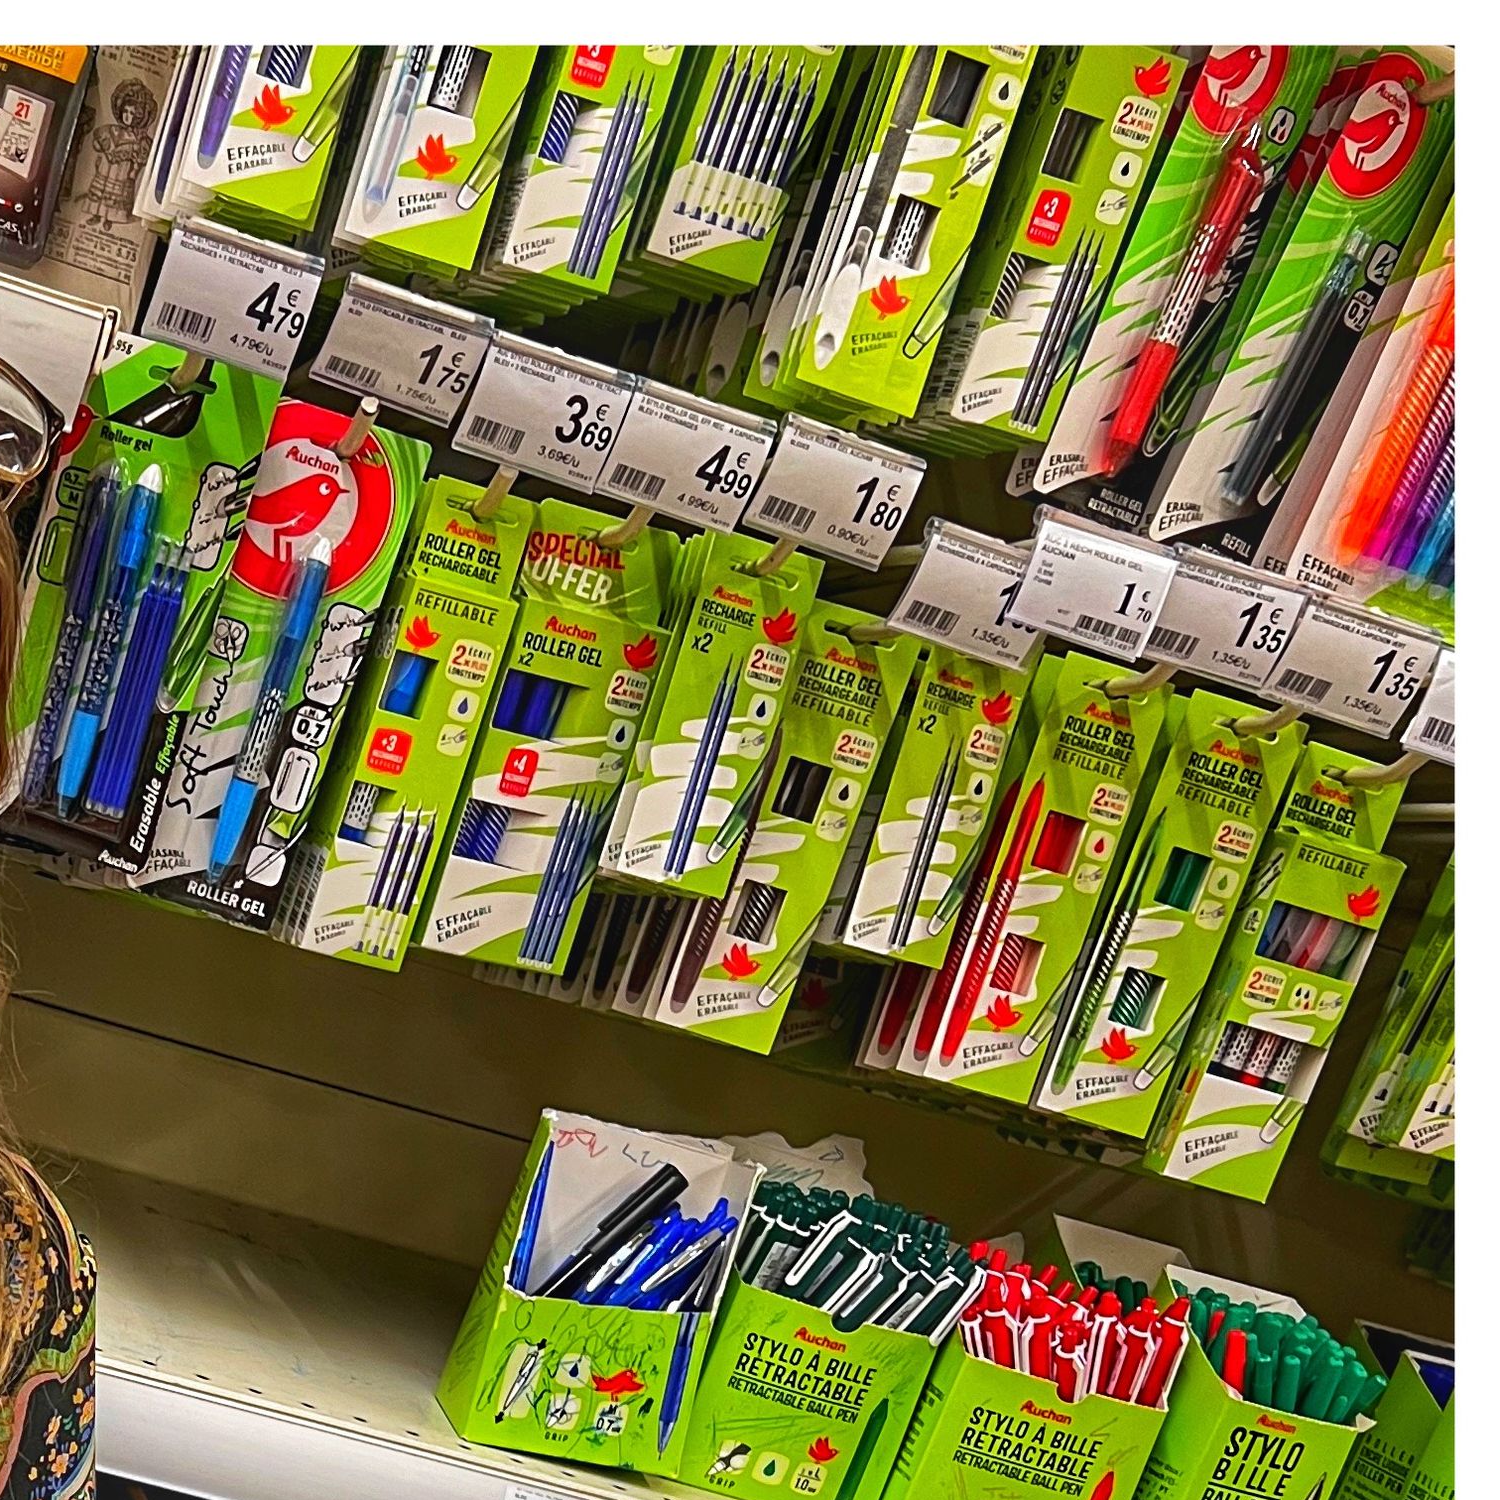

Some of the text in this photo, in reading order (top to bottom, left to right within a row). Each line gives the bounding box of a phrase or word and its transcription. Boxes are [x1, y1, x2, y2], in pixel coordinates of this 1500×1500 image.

[15, 101, 31, 119] 21
[1112, 125, 1150, 144] LONGTEMPS
[227, 143, 287, 161] EFFAÇABLE
[228, 157, 273, 174] ERASABLE
[100, 426, 154, 452] Roller gel
[286, 445, 340, 474] Auchan
[528, 531, 625, 570] SPECIAL
[1222, 533, 1251, 558] REFILL
[418, 553, 499, 585] RECHARGEABLE
[531, 555, 612, 604] OFFER
[1302, 554, 1354, 585] EFFAÇABLE
[415, 591, 496, 626] REFILLABLE
[701, 598, 756, 628] RECHARGE
[545, 615, 597, 642] Auchan
[697, 616, 727, 634] REFILL
[522, 631, 603, 668] ROLLER GEL
[691, 633, 713, 652] x2
[797, 676, 879, 710] RECHARGEABLE
[805, 660, 882, 697] ROLLER GEL
[792, 694, 873, 727] REFILLABLE
[927, 681, 974, 709] RECHARGE
[917, 714, 937, 734] x2
[1060, 733, 1132, 762] RECHARGEABLE
[130, 713, 180, 853] Erasable Effaçable
[1182, 767, 1259, 802] RECHARGEABLE
[1188, 751, 1262, 790] ROLLER GEL
[1176, 784, 1251, 818] REFILLABLE
[1297, 843, 1369, 880] REFILLABLE
[186, 880, 266, 918] ROLLER GEL
[436, 904, 492, 929] EFFAÇABLE
[437, 919, 480, 944] ERASABLE
[1185, 1129, 1239, 1152] EFFAÇABLE
[1185, 1143, 1226, 1163] ERASABLE
[744, 1332, 804, 1366] STYLO
[825, 1358, 877, 1386] BILLE
[728, 1376, 858, 1424] RETRACTABLE BALL PEN
[969, 1406, 1030, 1439] STYLO
[1050, 1430, 1102, 1459] BILLE
[1223, 1425, 1305, 1476] STYLO
[952, 1450, 1084, 1497] RETRACTABLE BALL PEN
[1211, 1456, 1293, 1496] BILLE
